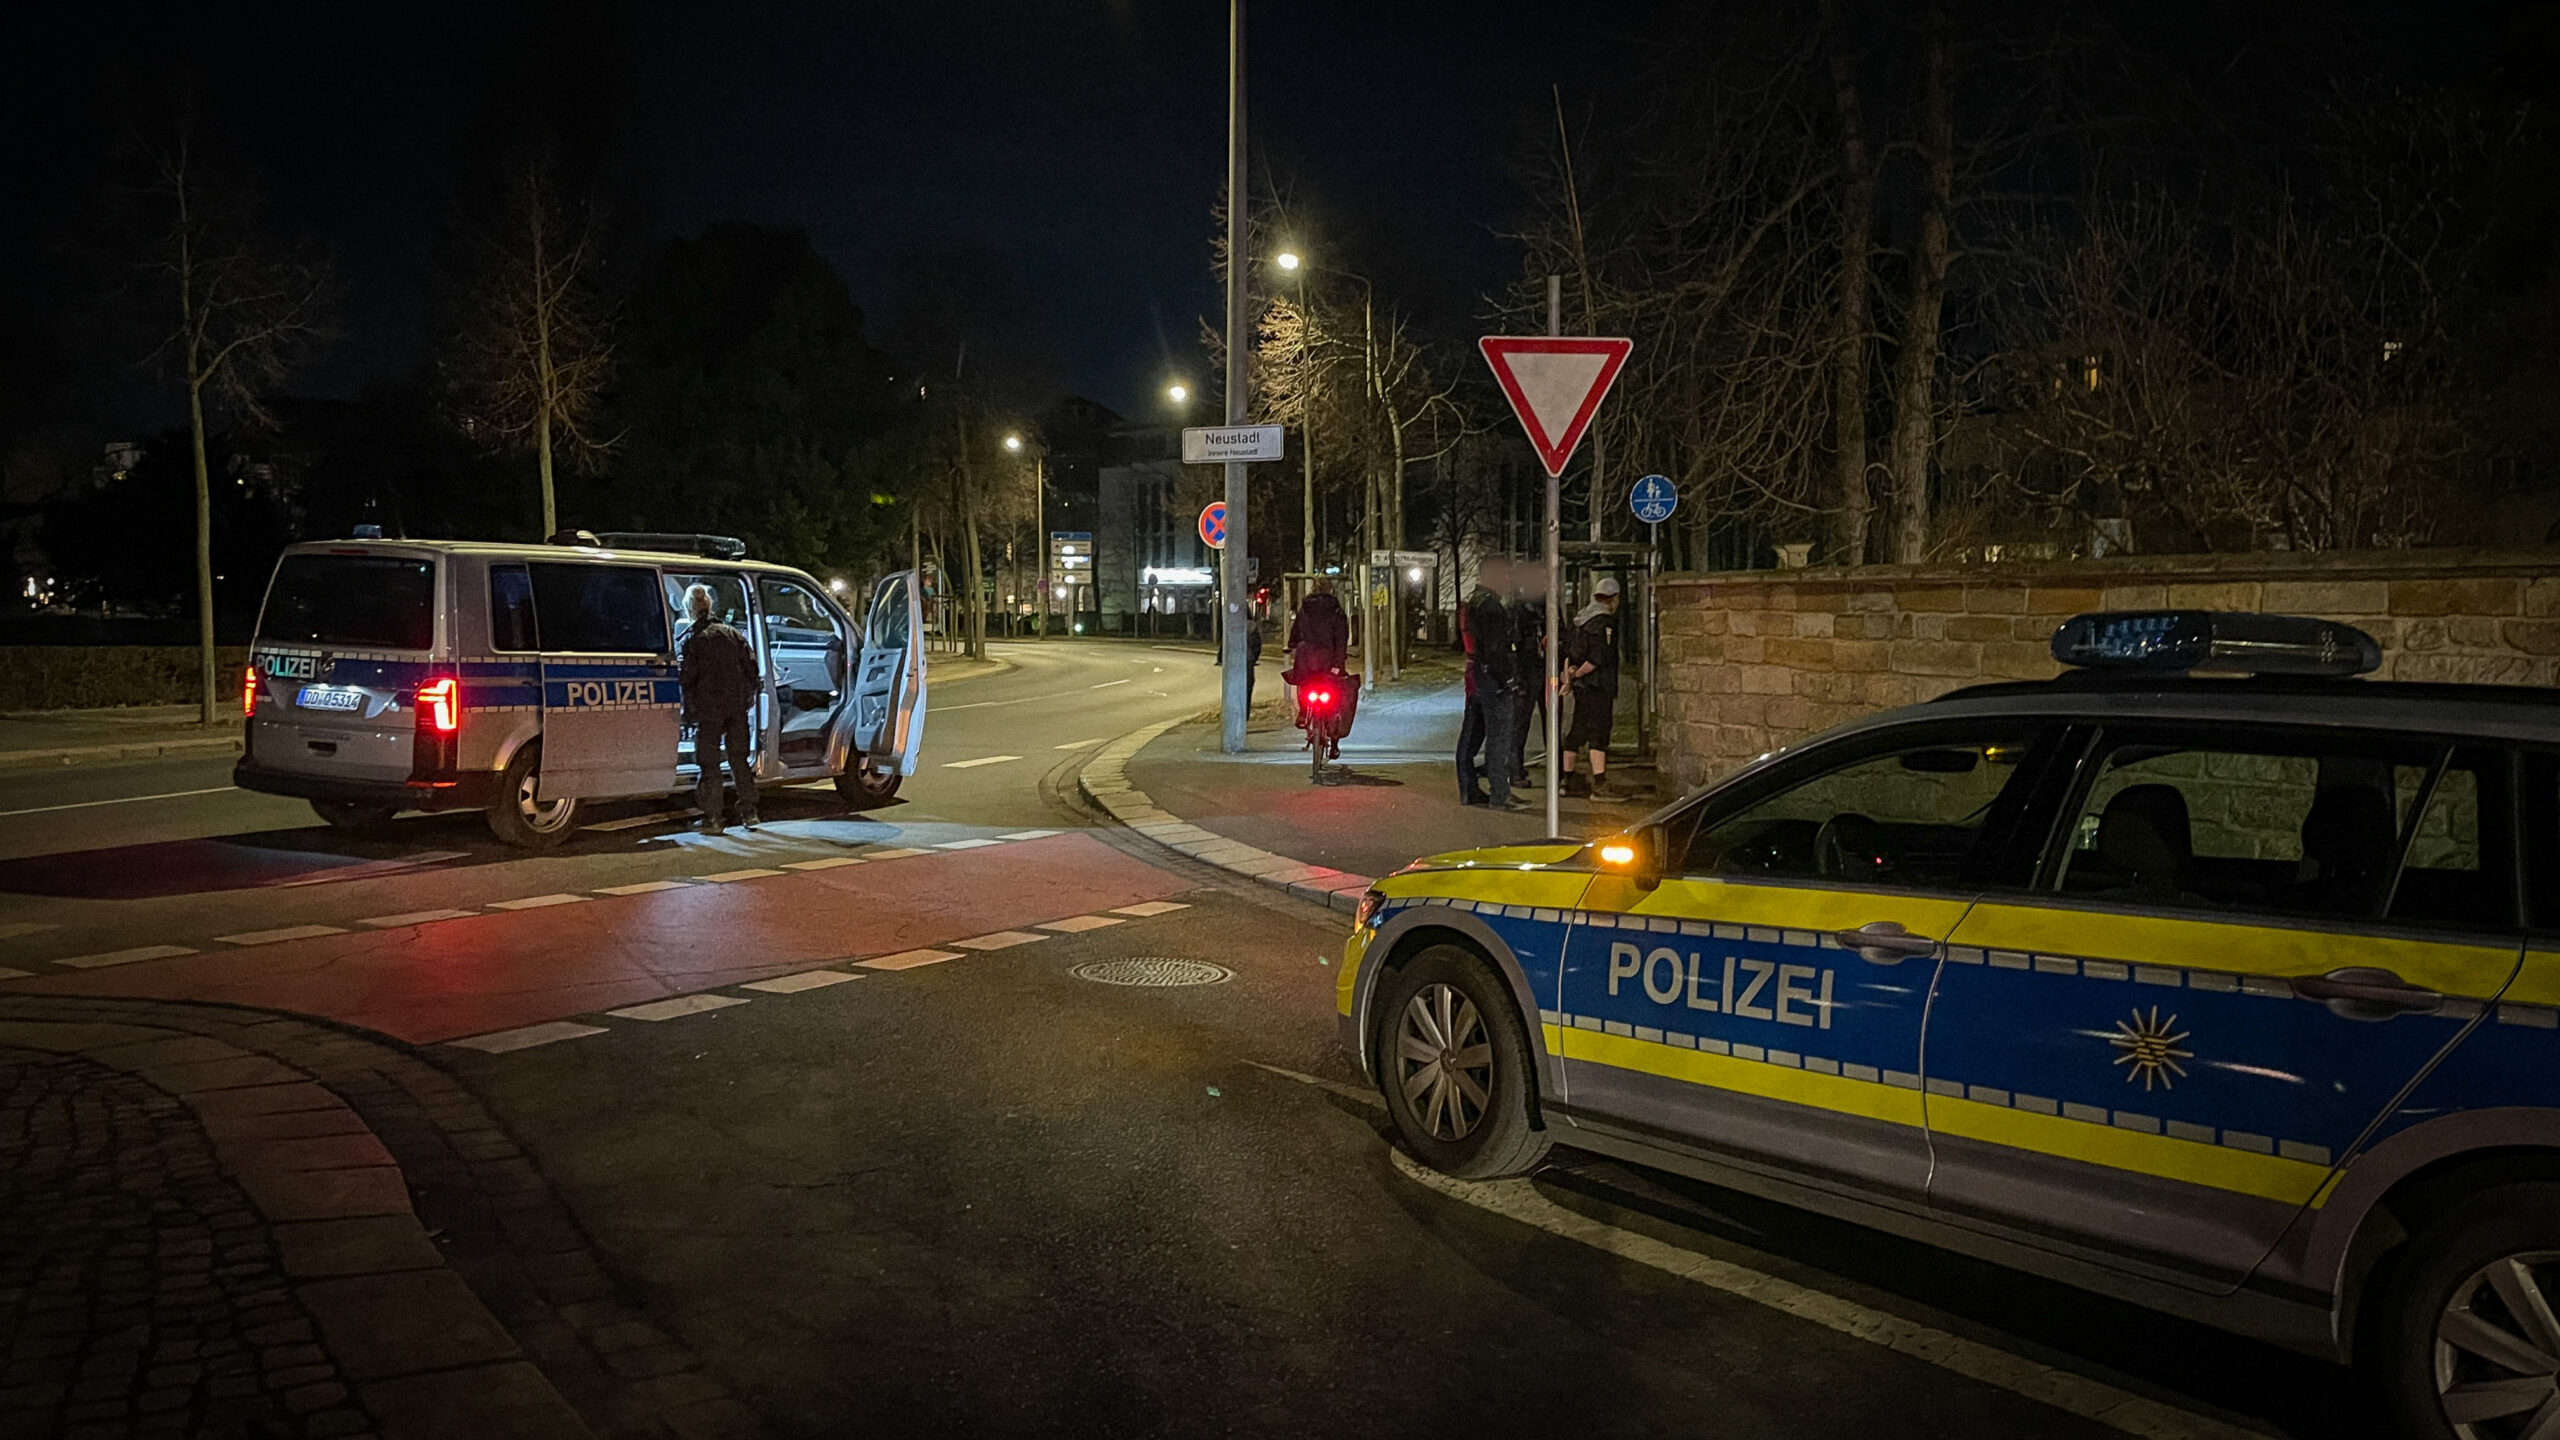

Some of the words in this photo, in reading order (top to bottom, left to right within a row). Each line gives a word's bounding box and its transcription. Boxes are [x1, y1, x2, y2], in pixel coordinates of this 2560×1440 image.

[1205, 431, 1260, 445] Neustadt
[256, 654, 316, 679] POLIZEI
[567, 681, 656, 706] POLIZEI
[1608, 941, 1834, 1030] POLIZEI
